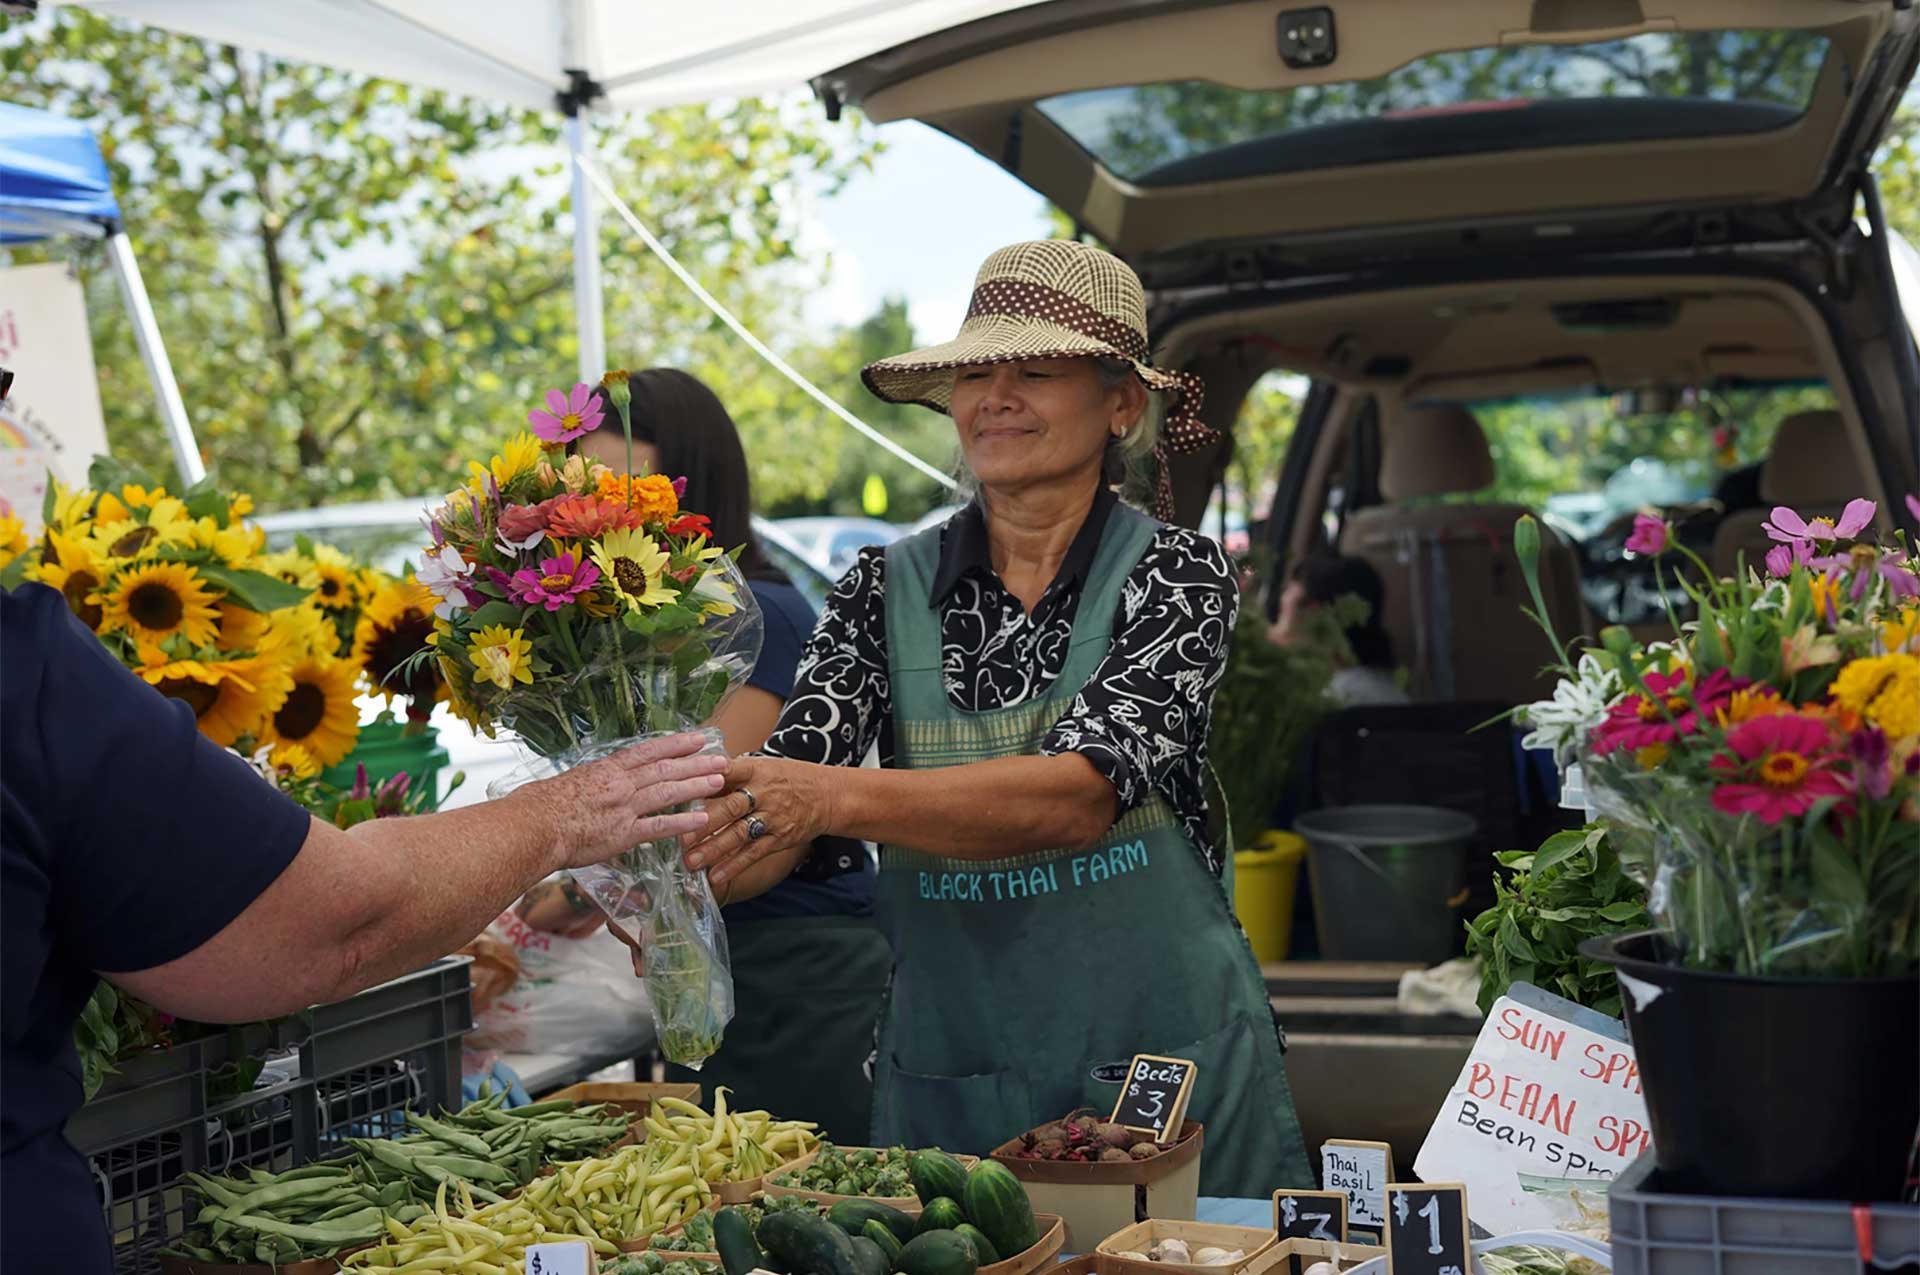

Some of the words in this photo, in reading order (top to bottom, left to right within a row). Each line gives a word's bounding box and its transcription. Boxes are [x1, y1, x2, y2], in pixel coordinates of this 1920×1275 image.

[919, 871, 984, 902] BLACK
[988, 863, 1059, 901] THAI
[1071, 839, 1149, 887] FARM
[1496, 1008, 1566, 1061] SUN
[1134, 1060, 1185, 1084] Beets
[1467, 1062, 1577, 1136] BEAN
[1457, 1100, 1536, 1153] Bean
[1327, 1152, 1359, 1175] Thai
